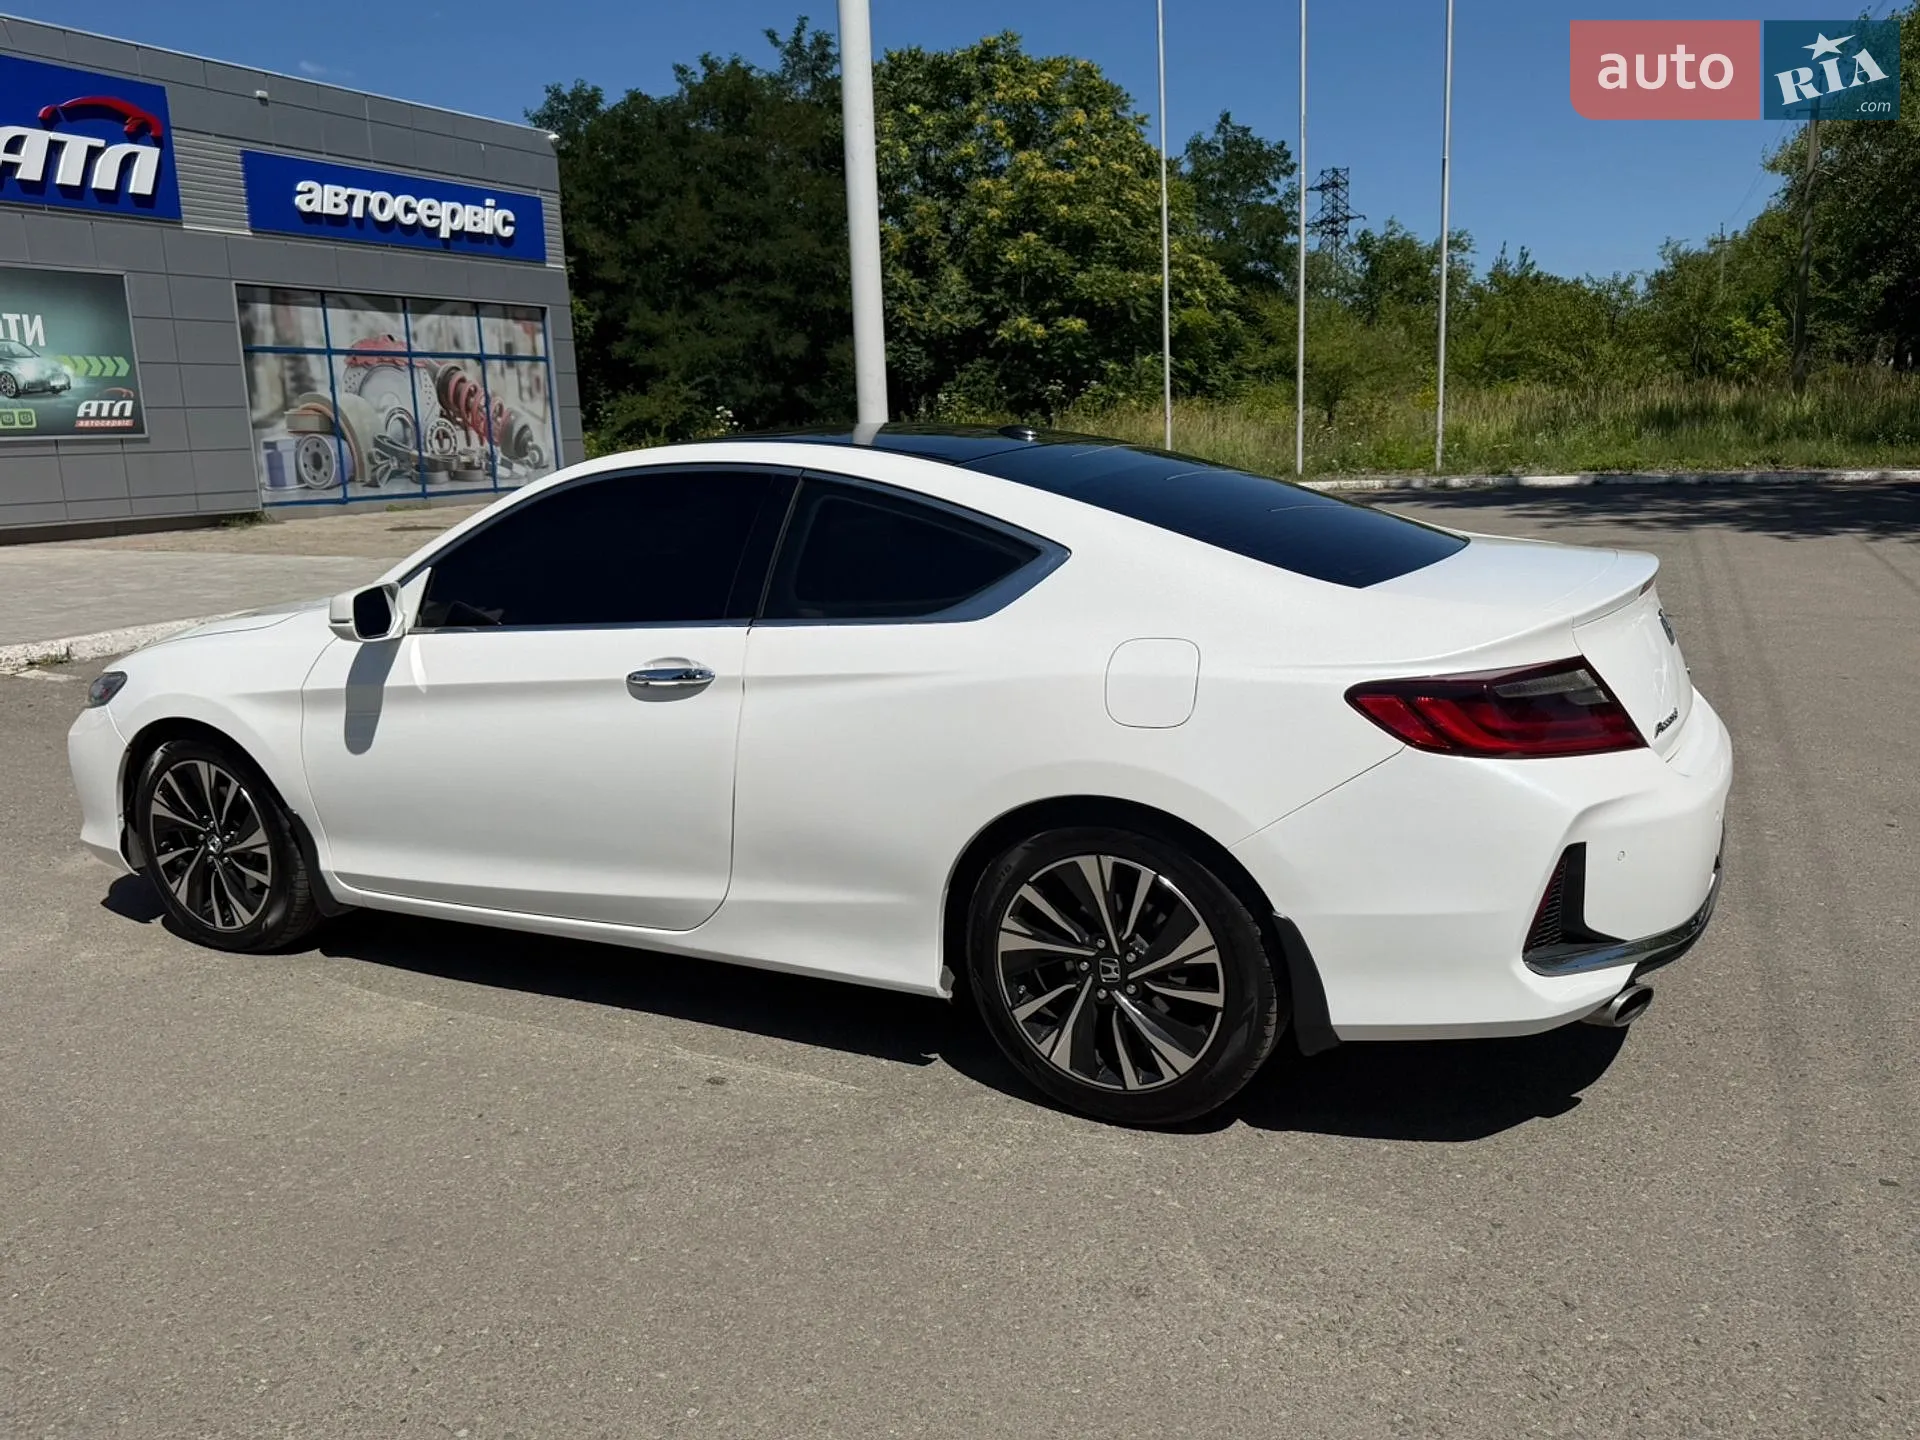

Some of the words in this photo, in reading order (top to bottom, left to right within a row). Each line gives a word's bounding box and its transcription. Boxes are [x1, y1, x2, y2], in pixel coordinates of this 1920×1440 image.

[294, 180, 516, 238] автосервіс
[0, 313, 46, 347] ТИ
[77, 400, 133, 417] АТЛ
